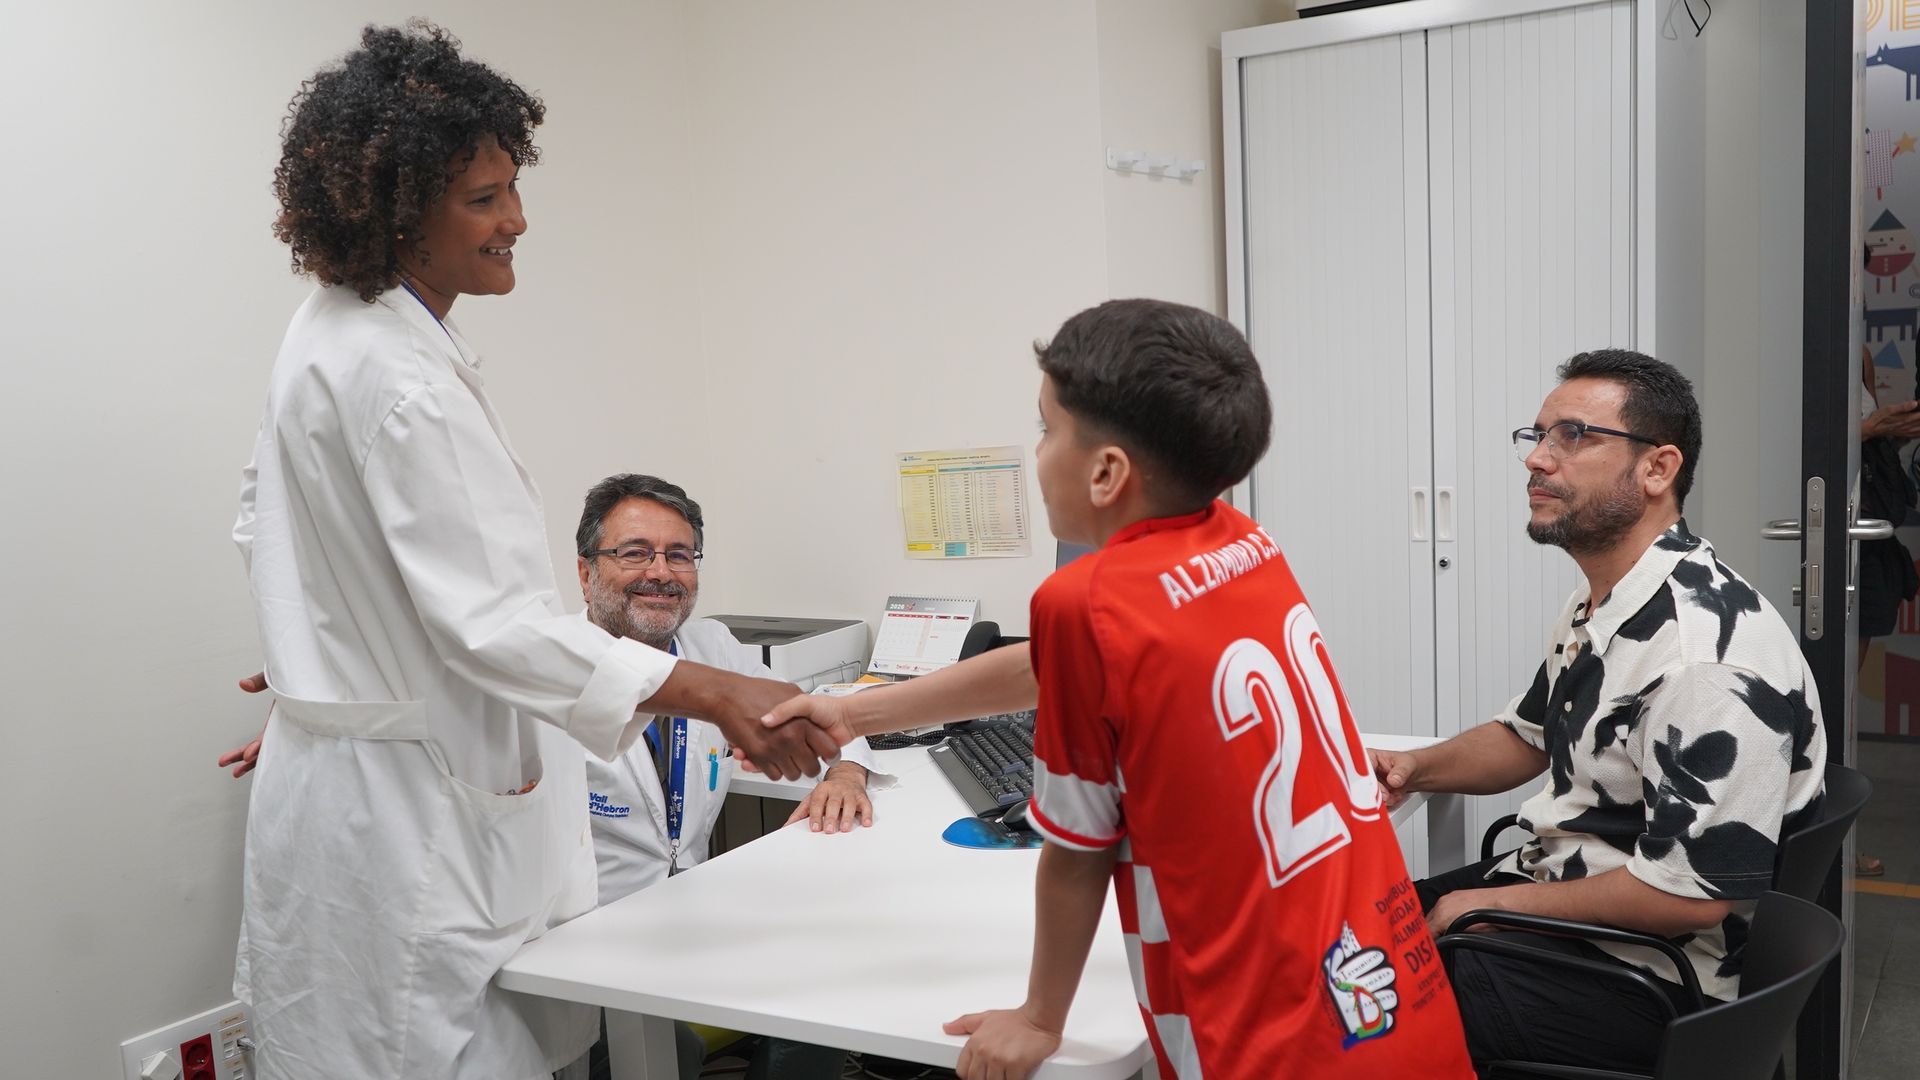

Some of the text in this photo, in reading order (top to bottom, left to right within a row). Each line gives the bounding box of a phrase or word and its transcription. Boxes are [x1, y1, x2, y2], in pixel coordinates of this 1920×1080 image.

[1159, 539, 1262, 609] ALZAMORA
[1212, 603, 1382, 889] 20
[590, 792, 608, 803] Vall
